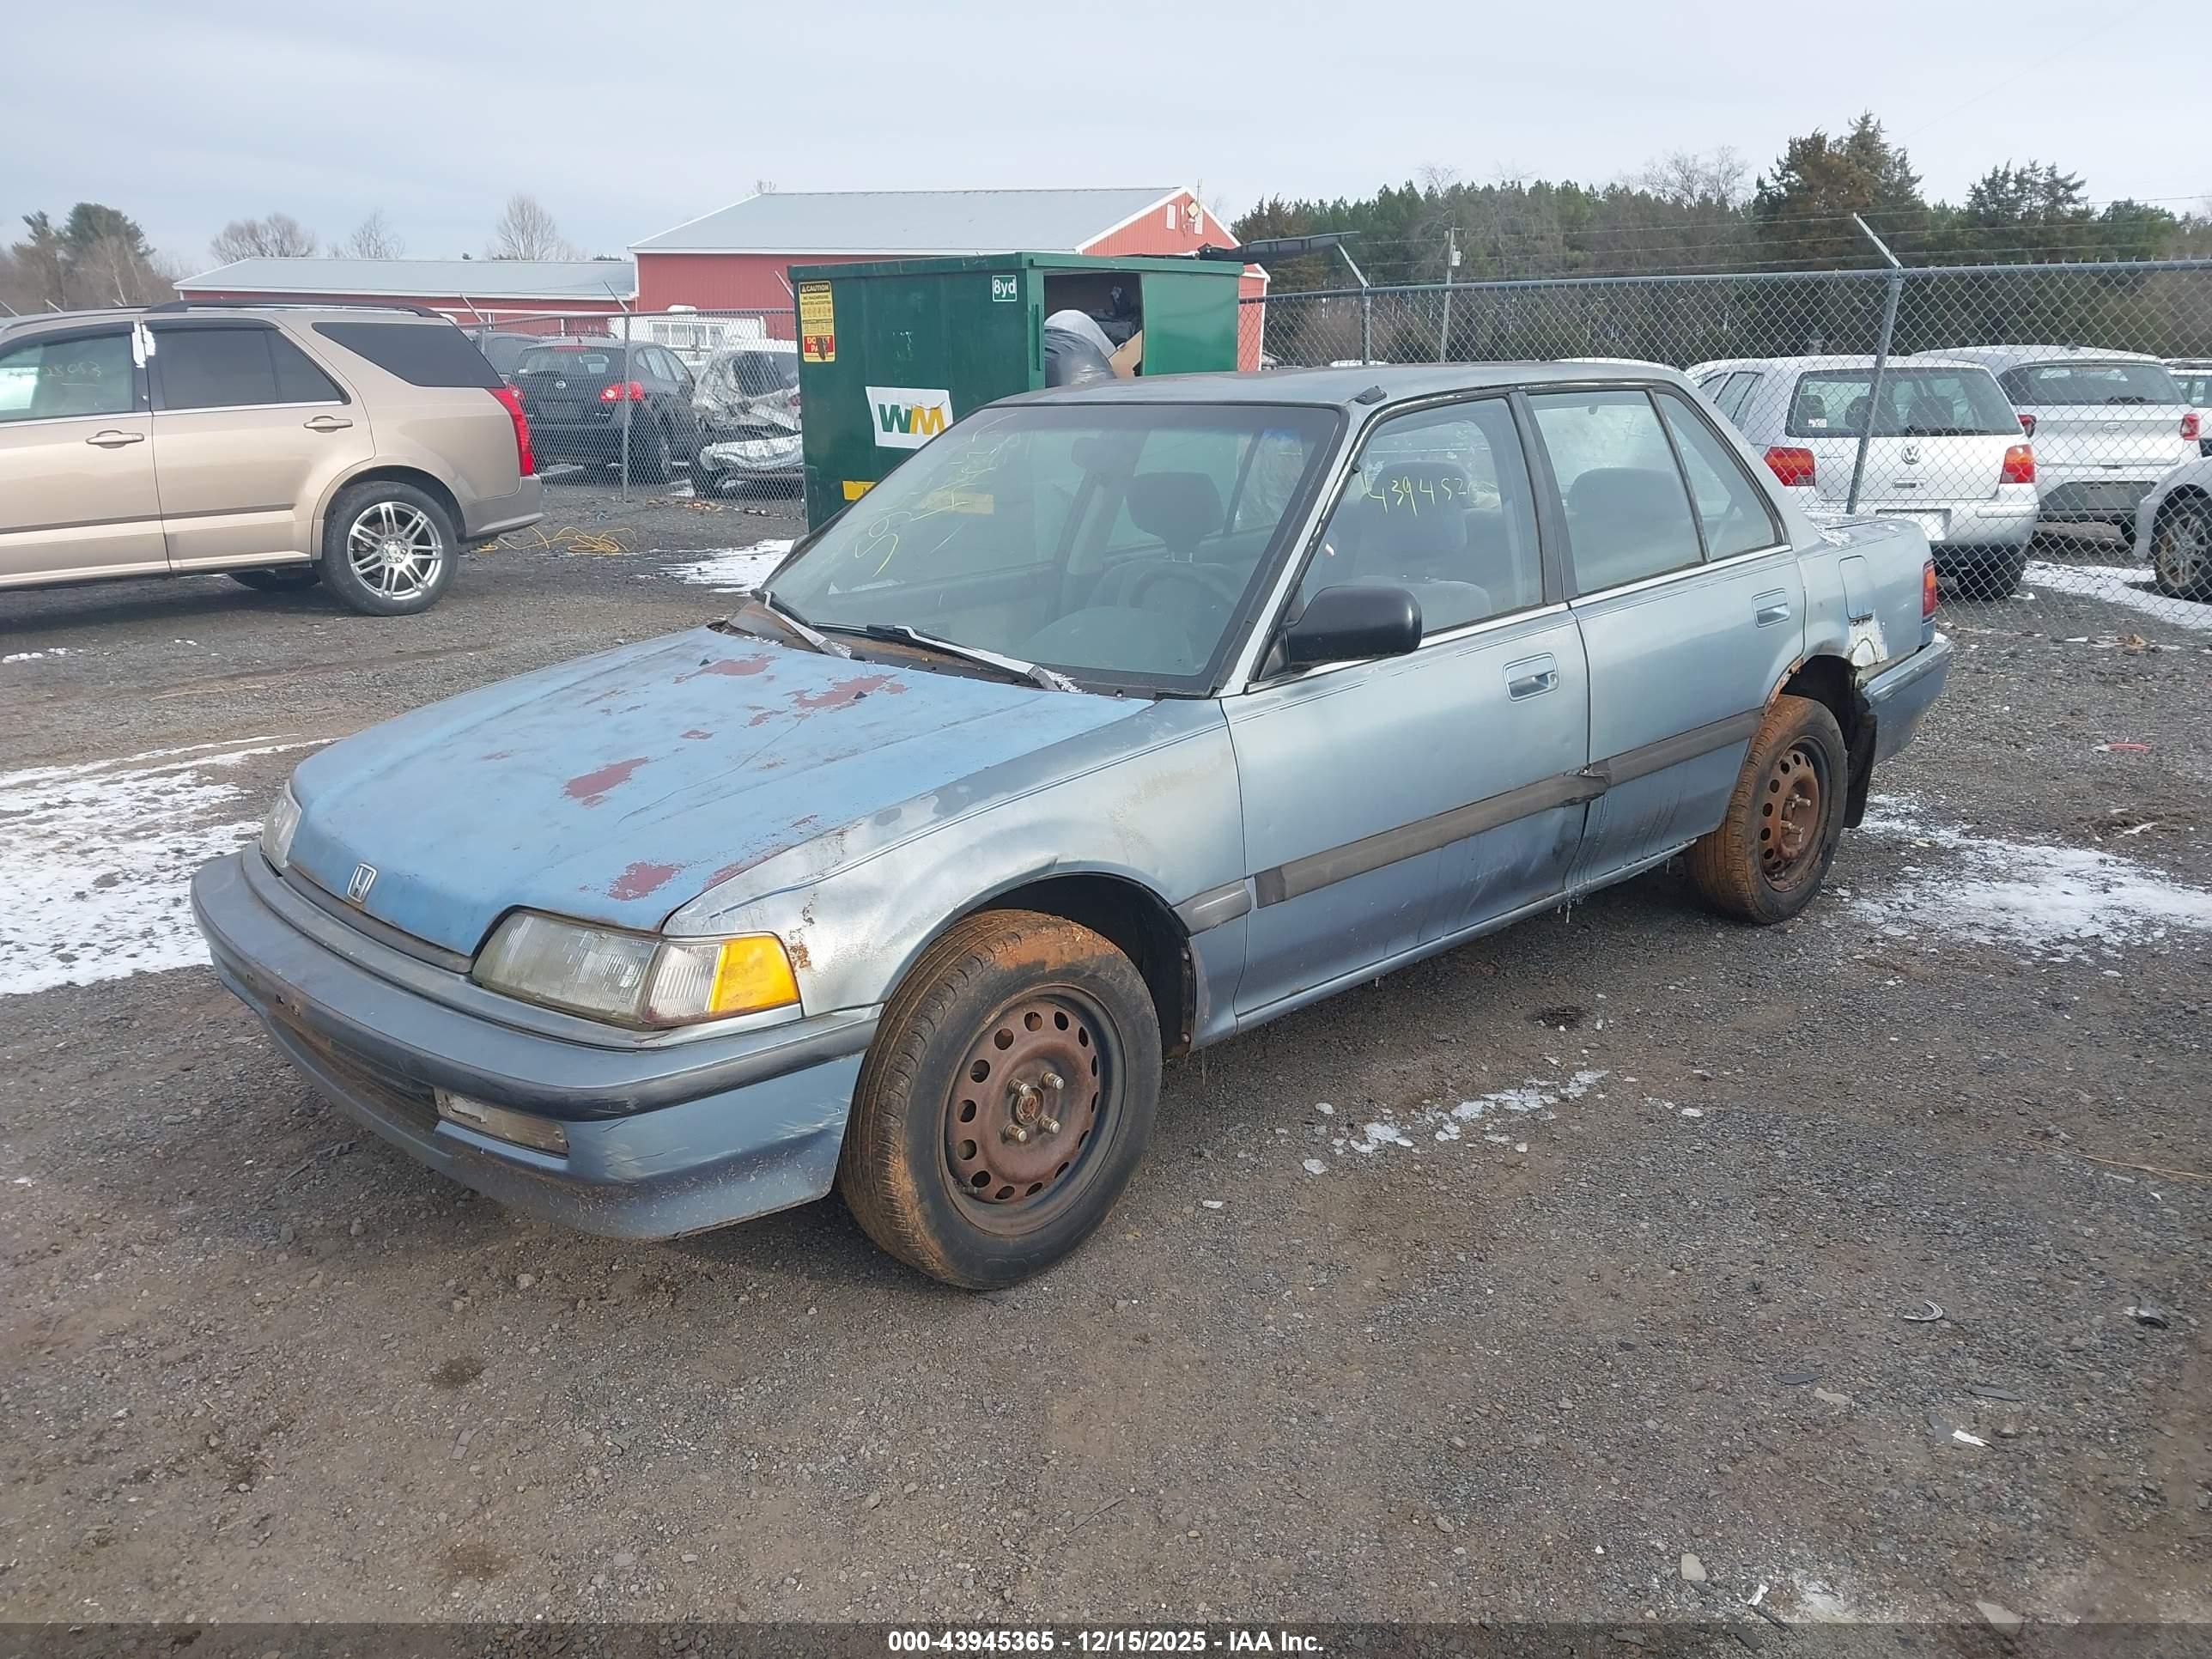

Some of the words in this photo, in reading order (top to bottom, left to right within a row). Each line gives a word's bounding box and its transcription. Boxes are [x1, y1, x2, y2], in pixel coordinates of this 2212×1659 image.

[806, 283, 830, 292] CAUTION
[994, 278, 1016, 298] 8yd
[878, 403, 946, 436] WM
